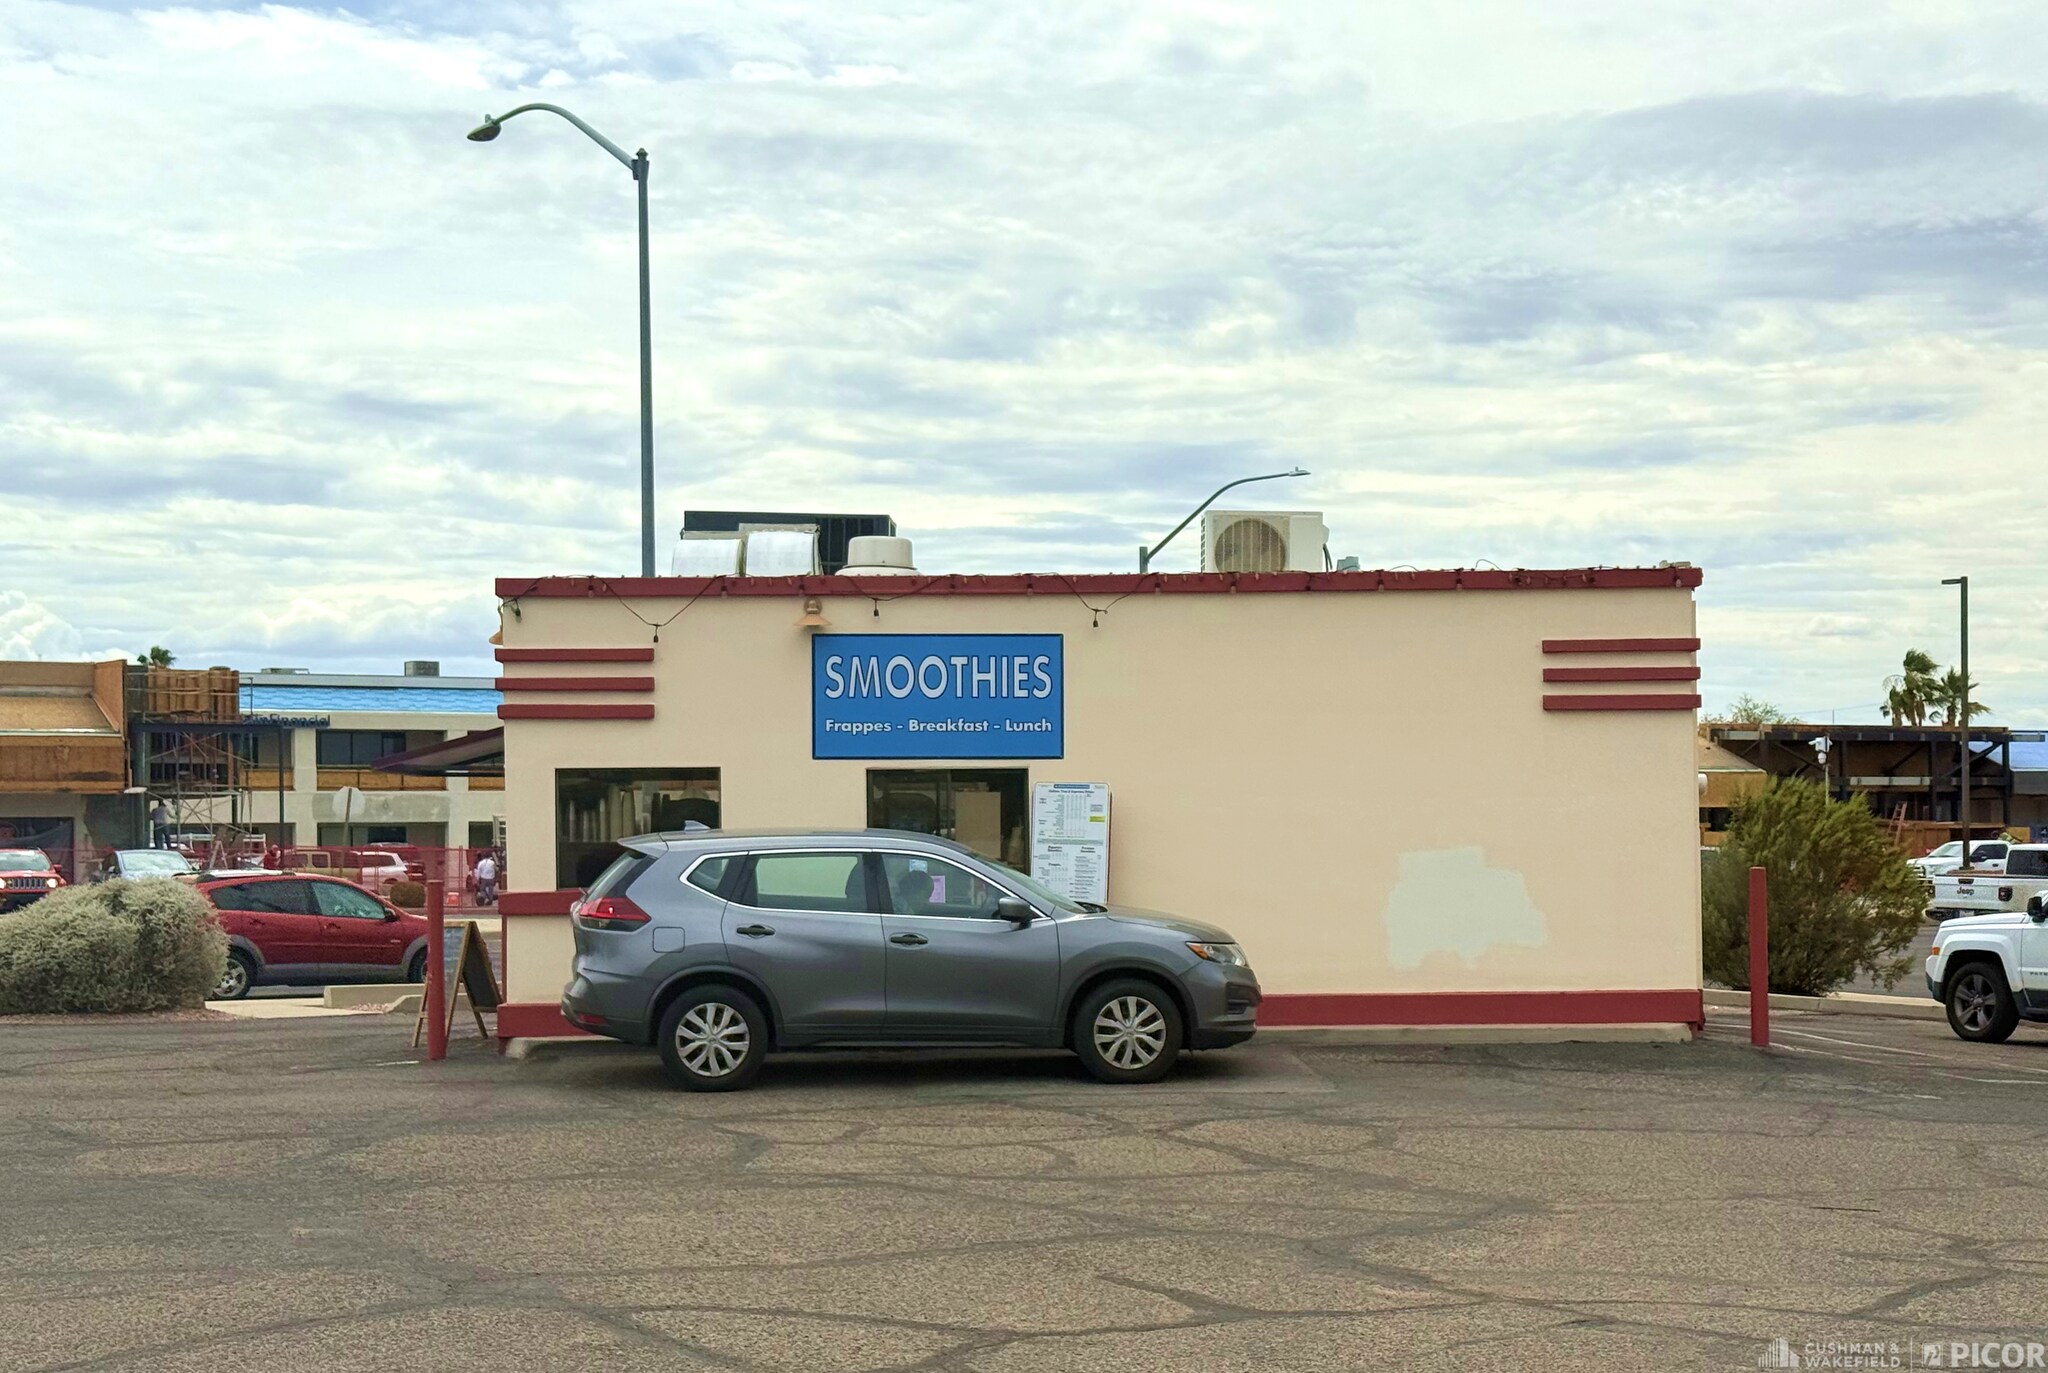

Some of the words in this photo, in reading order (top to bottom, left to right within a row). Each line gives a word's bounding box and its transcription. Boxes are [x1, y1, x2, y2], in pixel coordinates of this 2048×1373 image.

[824, 654, 1053, 699] SMOOTHIES
[825, 719, 892, 736] Frappes
[908, 718, 989, 733] Breakfast
[1005, 718, 1052, 733] Lunch
[1956, 886, 1975, 896] Jeep
